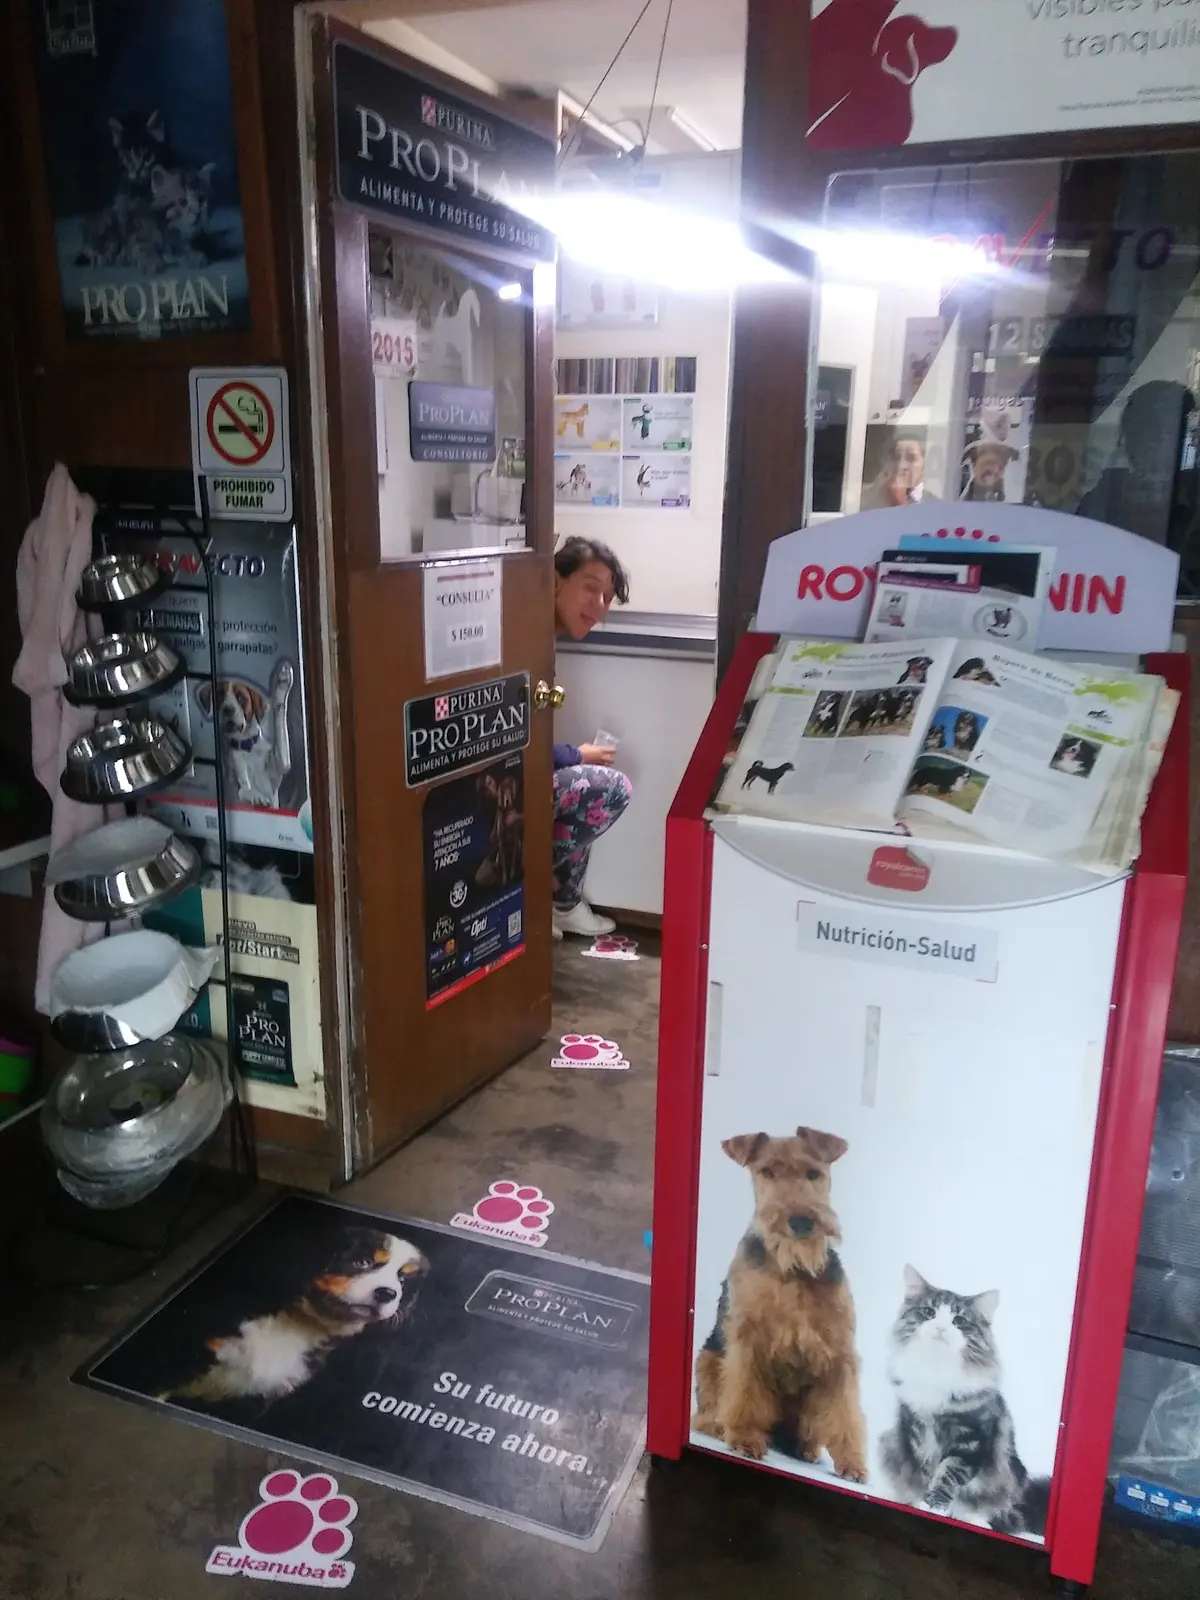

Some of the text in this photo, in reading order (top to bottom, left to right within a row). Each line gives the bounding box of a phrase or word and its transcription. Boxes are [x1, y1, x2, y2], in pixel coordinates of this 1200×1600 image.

[437, 107, 494, 147] PURINA
[360, 176, 425, 213] ALIMENTA
[428, 199, 435, 216] Y
[440, 200, 489, 233] PROTEGE
[492, 220, 506, 239] SU
[373, 332, 413, 366] 2015
[213, 479, 275, 494] PROHIBIDO
[225, 495, 264, 508] FUMAR
[223, 620, 278, 634] protección
[451, 683, 501, 714] PURINA
[410, 730, 525, 776] ALIMENTA Y PROTEGE SU SALUD
[816, 920, 977, 962] Nutrición-Salud
[245, 1013, 280, 1034] PRO
[453, 1214, 528, 1241] Eukanuba
[433, 1371, 559, 1426] Su futuro
[362, 1390, 496, 1445] comienza
[211, 1550, 326, 1580] Eukanuba
